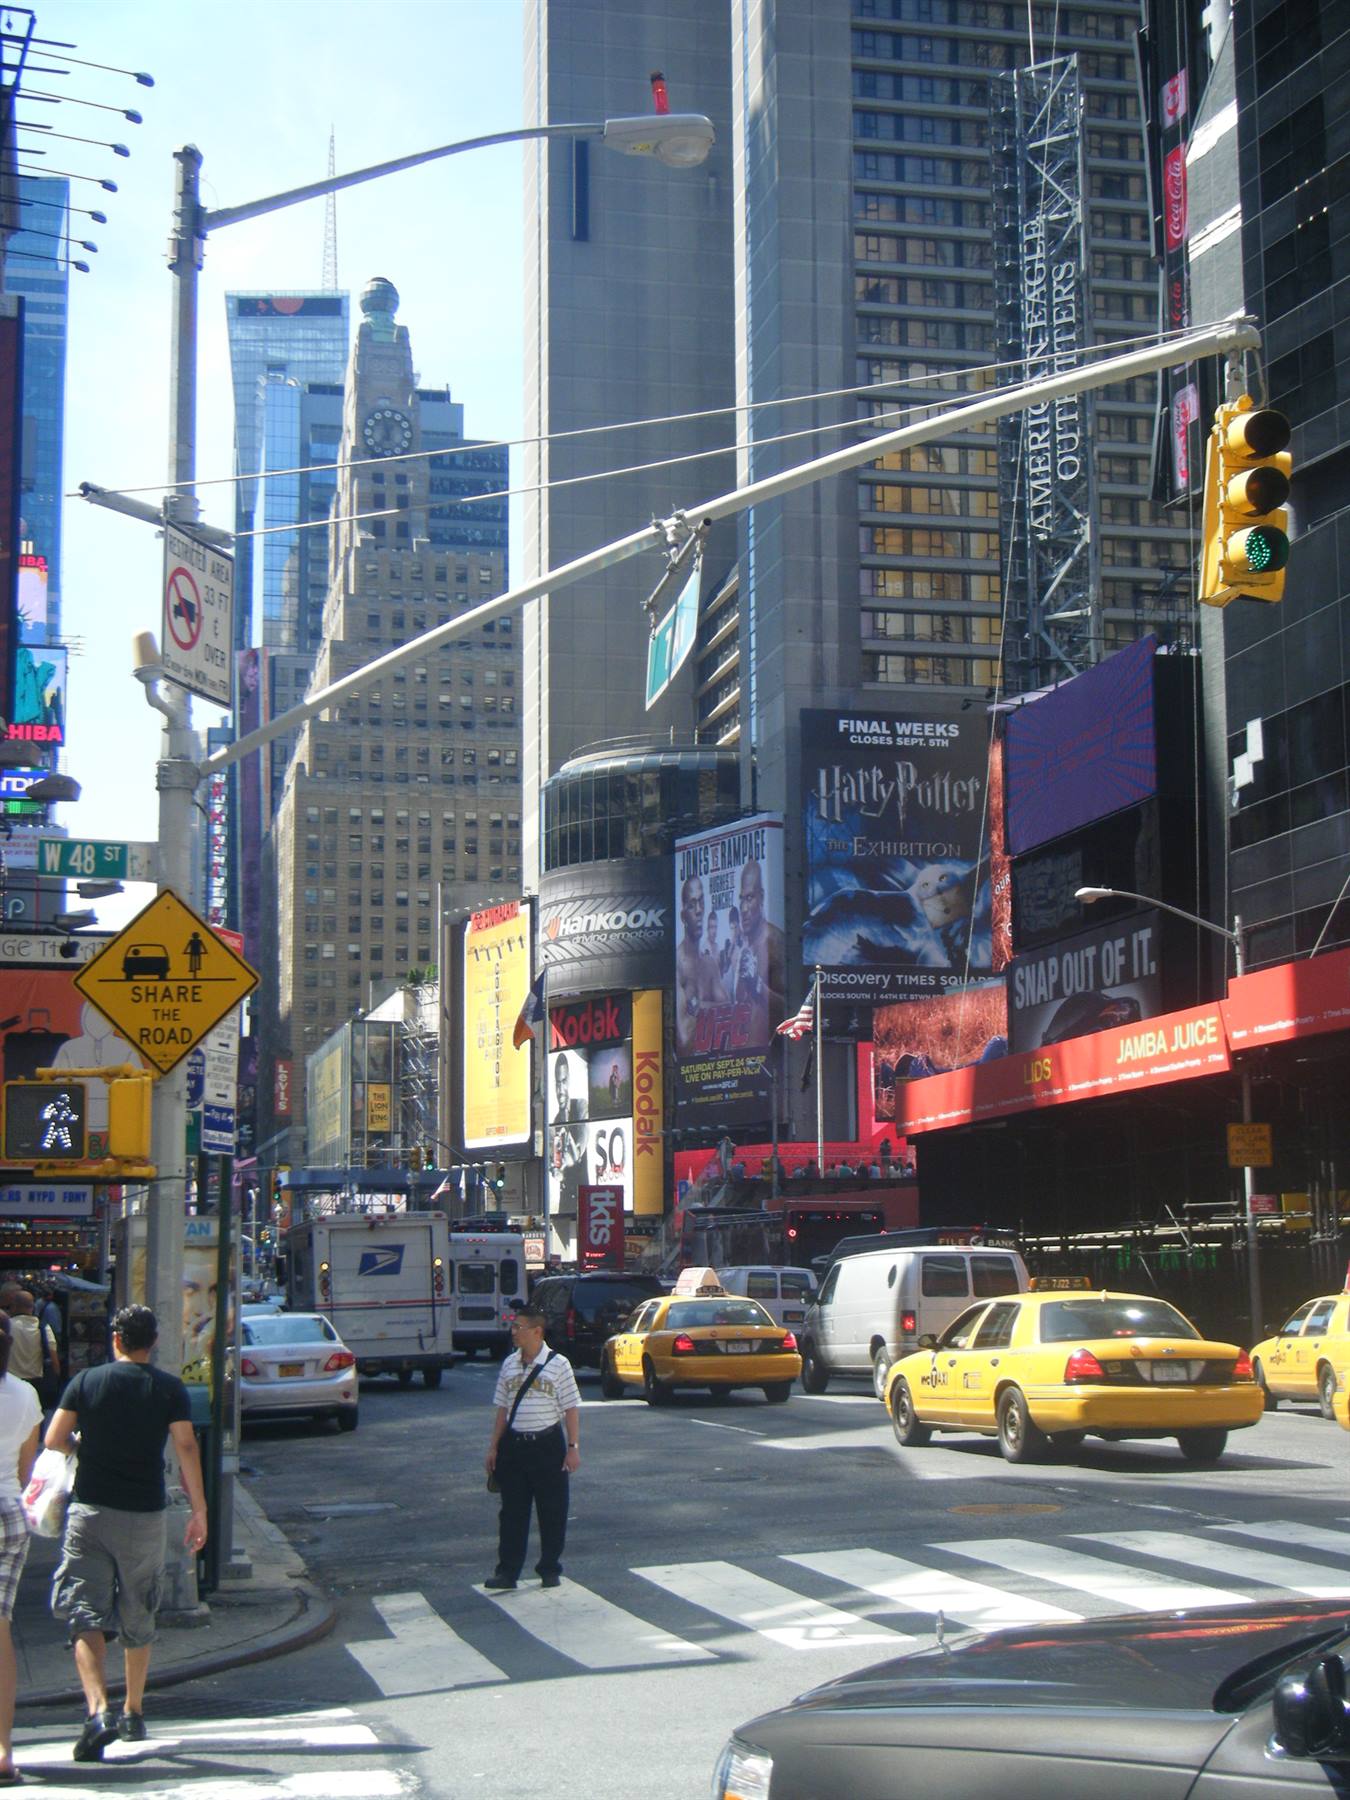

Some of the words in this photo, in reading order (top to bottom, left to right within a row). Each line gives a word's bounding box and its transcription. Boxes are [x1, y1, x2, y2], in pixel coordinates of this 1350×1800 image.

[1023, 219, 1048, 331] EAGLE
[1051, 260, 1081, 482] OUTFTTERS
[19, 556, 46, 567] IBA
[168, 533, 207, 574] RESTRICTED
[211, 559, 230, 586] AREA
[203, 584, 215, 607] 33
[217, 591, 229, 614] FT
[204, 642, 226, 669] OVER
[5, 723, 63, 742] HIBA
[838, 719, 891, 735] FINAL
[895, 721, 960, 738] WEEKS
[849, 735, 893, 746] CLOSES
[896, 736, 927, 747] SEPT.
[929, 738, 949, 748] 5TH
[812, 764, 897, 824] Harry
[895, 760, 981, 829] Potter
[44, 842, 62, 873] W
[69, 843, 96, 875] 48
[104, 845, 122, 862] ST
[680, 845, 710, 882] JONES
[721, 829, 766, 870] RAMPAGE
[852, 836, 961, 858] EXHIBITION
[571, 932, 608, 945] driving
[608, 928, 665, 941] emotion
[895, 974, 936, 986] TIMES
[939, 975, 996, 987] SQUA
[1014, 956, 1059, 1010] SNAP
[1062, 945, 1097, 997] OUT
[1101, 937, 1126, 987] OF
[1132, 928, 1157, 979] IT.
[131, 985, 203, 1003] SHARE
[152, 1008, 181, 1022] THE
[549, 994, 620, 1050] Kodak
[139, 1027, 193, 1045] ROAD
[1115, 1028, 1169, 1065] JAMBA
[1170, 1015, 1219, 1053] JUICE
[680, 1061, 717, 1076] SATURDAY
[685, 1072, 700, 1084] LIVE
[700, 1070, 712, 1082] ON
[1023, 1057, 1053, 1085] LIDS
[635, 1050, 660, 1157] Kodak
[184, 1221, 212, 1237] AN
[590, 1189, 617, 1246] tkts
[987, 1239, 1016, 1248] BANK
